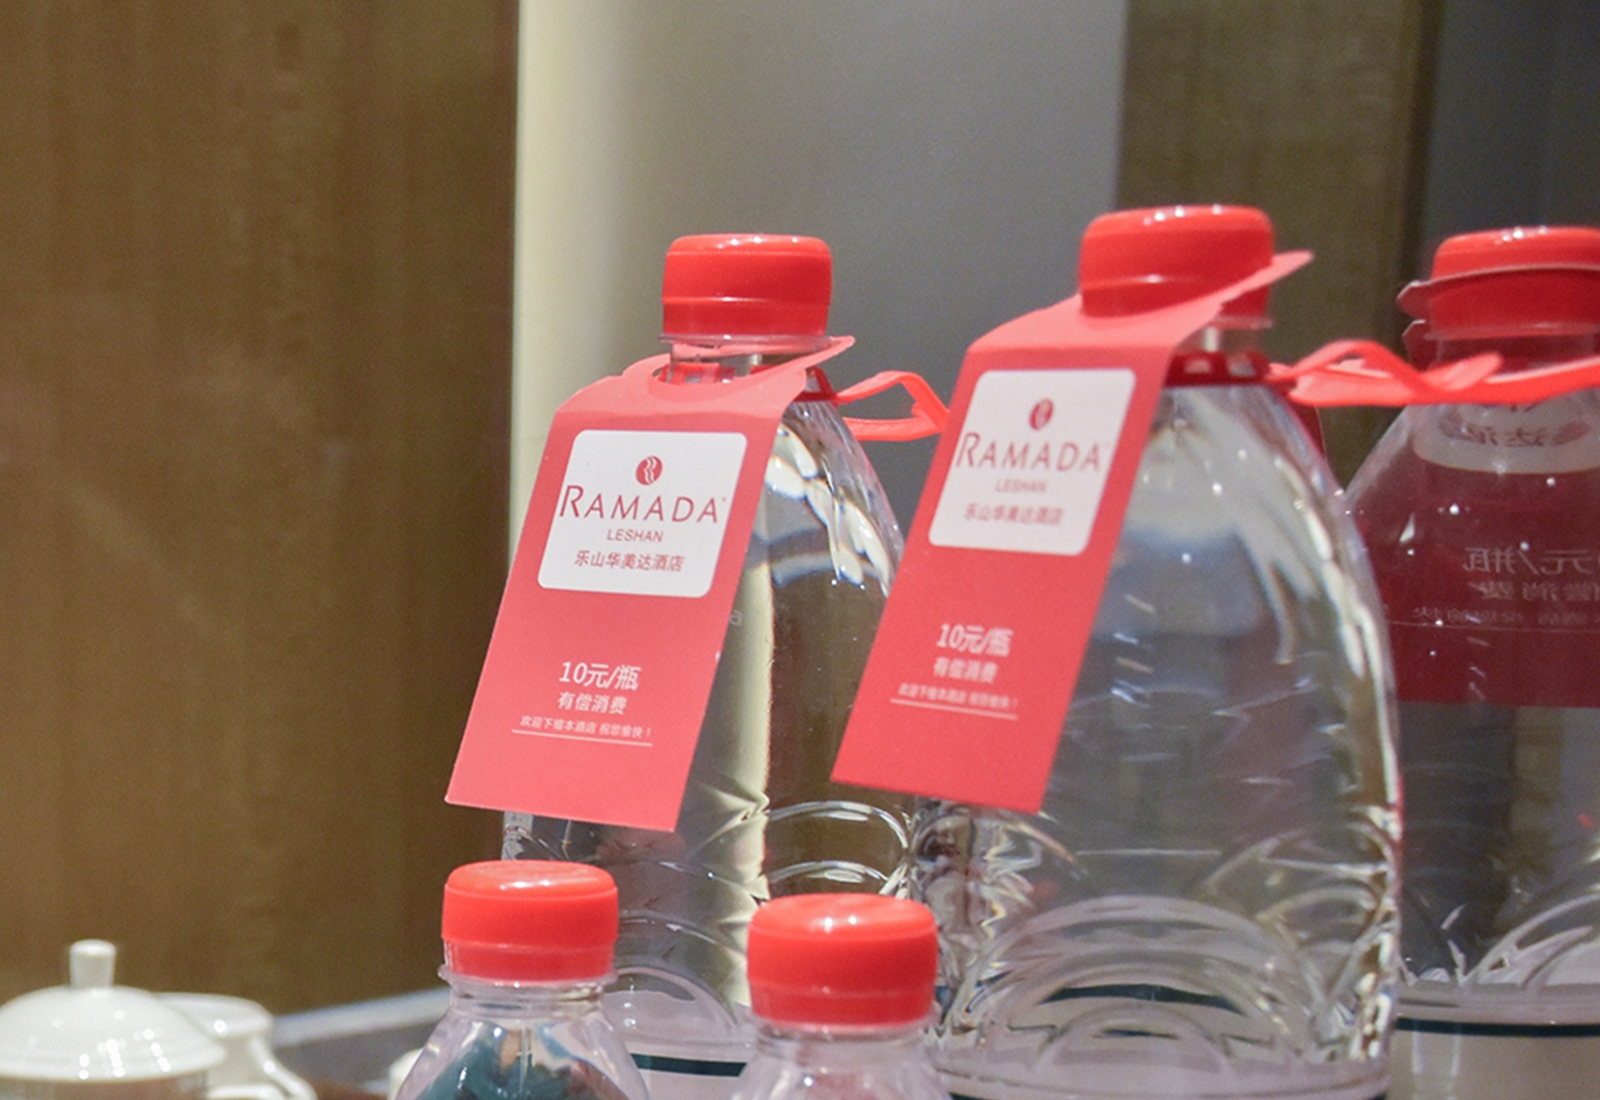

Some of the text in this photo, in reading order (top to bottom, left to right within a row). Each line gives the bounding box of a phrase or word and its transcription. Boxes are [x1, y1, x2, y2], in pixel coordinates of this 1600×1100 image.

[956, 431, 1101, 472] RAMADA
[559, 484, 718, 523] RAMADA
[606, 528, 664, 542] LESHAN
[574, 549, 685, 573] 乐山华美达酒店
[558, 661, 642, 691] 10元/瓶
[558, 691, 628, 715] 有偿消费
